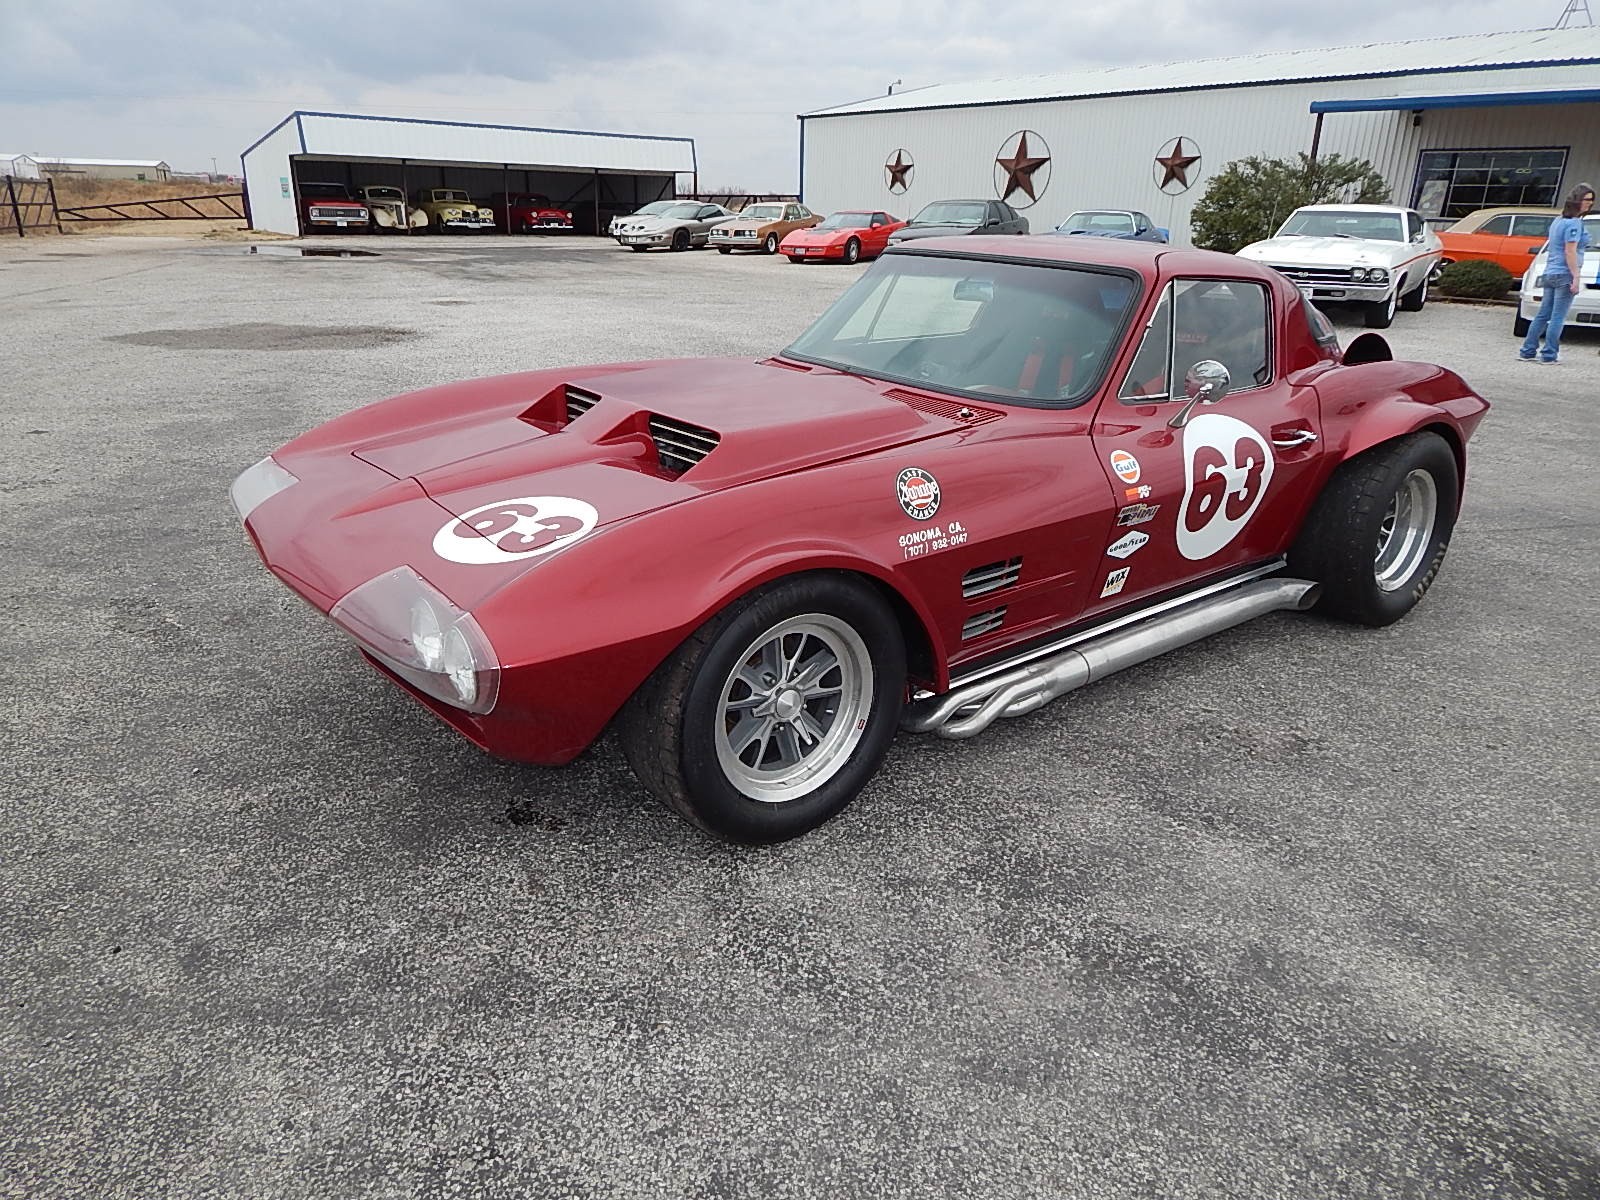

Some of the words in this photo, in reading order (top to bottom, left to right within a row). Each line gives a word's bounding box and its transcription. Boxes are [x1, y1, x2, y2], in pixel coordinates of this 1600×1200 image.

[901, 469, 922, 480] LAST
[1115, 460, 1137, 473] Gulf
[1184, 437, 1266, 533] 63
[907, 501, 937, 518] CHANCE
[453, 503, 585, 553] 63
[898, 526, 946, 547] SONOMA,
[948, 522, 966, 534] CA.
[904, 541, 929, 560] (707)
[1109, 536, 1147, 553] GOODYEAR
[1106, 568, 1128, 589] WIX
